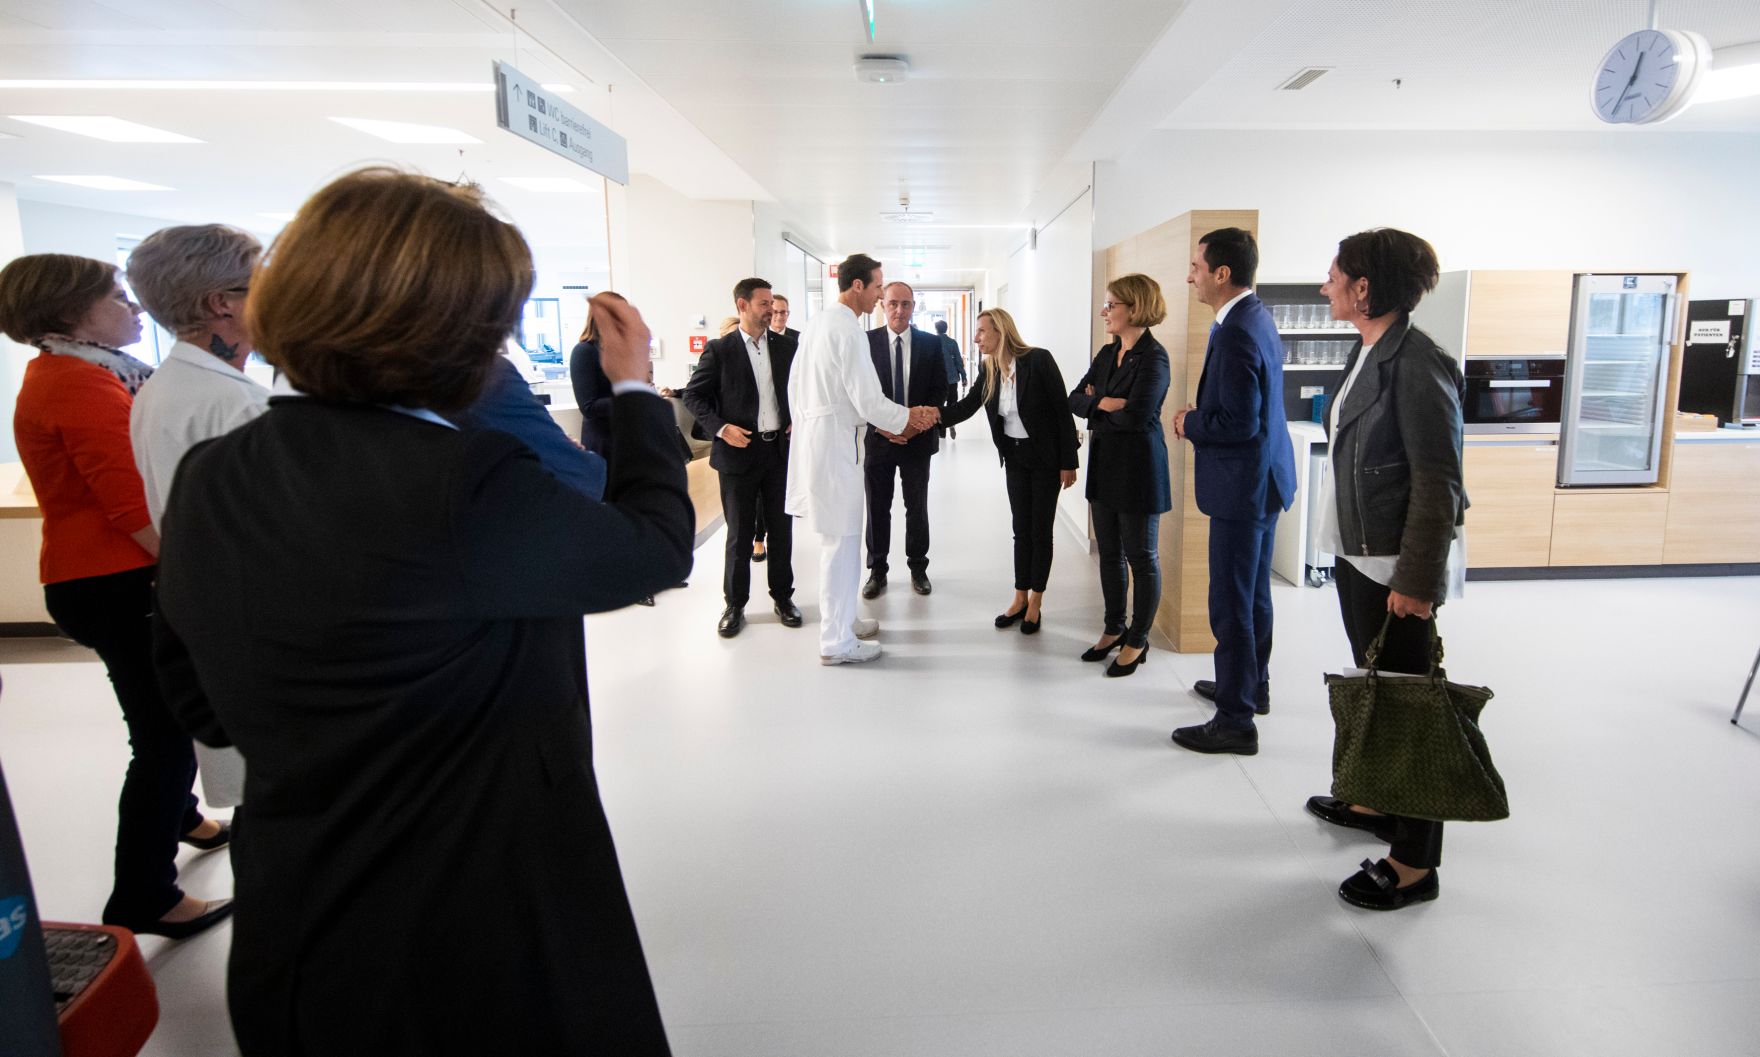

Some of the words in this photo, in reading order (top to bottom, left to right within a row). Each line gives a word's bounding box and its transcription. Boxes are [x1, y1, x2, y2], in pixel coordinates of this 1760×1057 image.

[547, 102, 560, 122] WC
[539, 120, 551, 140] Lift
[569, 136, 592, 163] Ausgang
